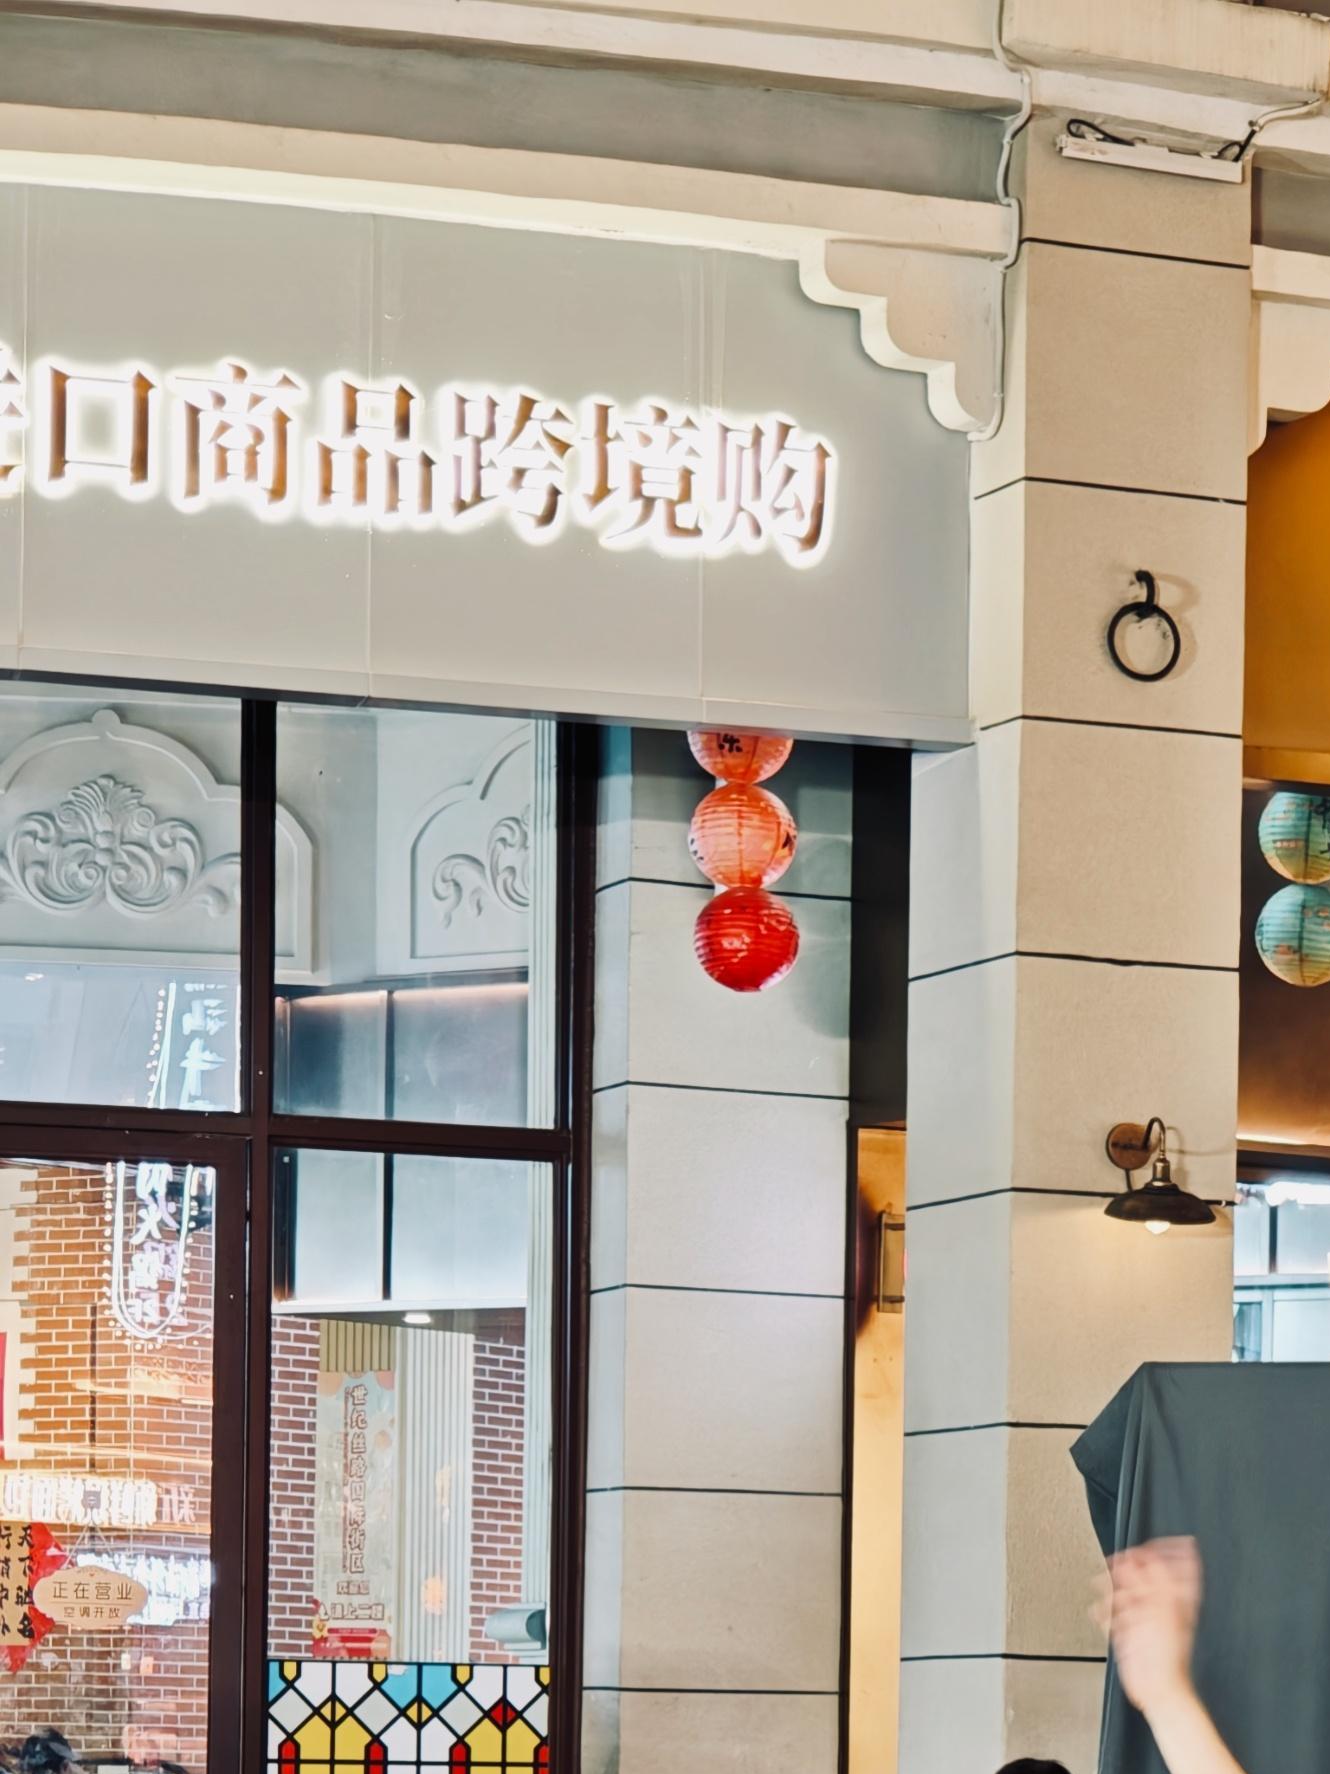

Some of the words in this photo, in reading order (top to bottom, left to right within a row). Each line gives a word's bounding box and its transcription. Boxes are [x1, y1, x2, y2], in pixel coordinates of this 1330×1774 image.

[0, 350, 834, 555] 口商品跨境购
[52, 1580, 133, 1601] 正在营业
[63, 1606, 120, 1619] 空调开放
